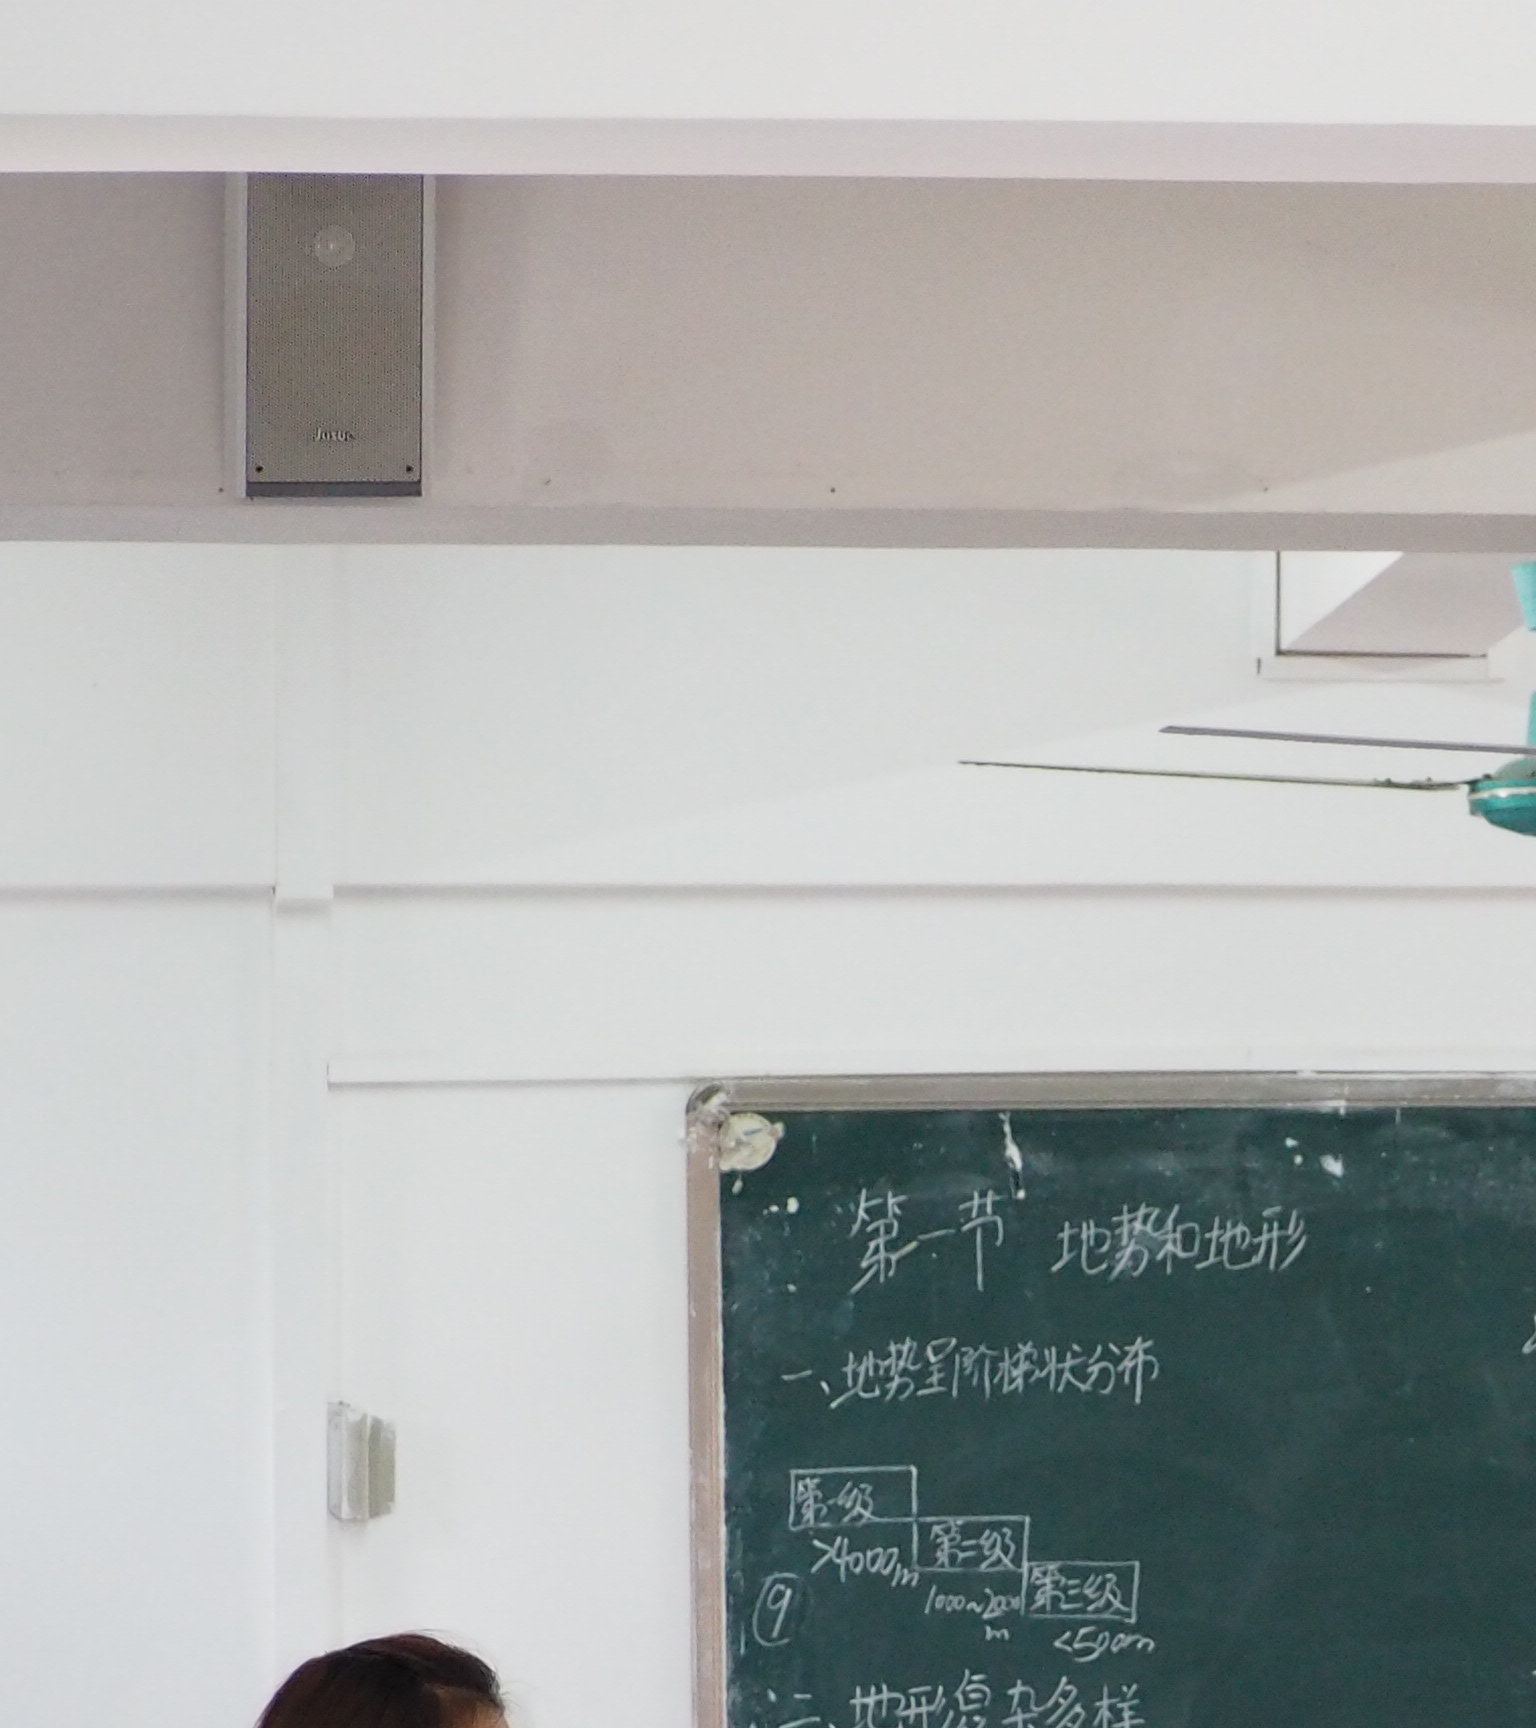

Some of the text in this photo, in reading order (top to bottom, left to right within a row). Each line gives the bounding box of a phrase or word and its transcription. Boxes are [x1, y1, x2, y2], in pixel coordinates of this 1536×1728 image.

[848, 1188, 1308, 1294] 第一节 地势和地形
[929, 1520, 1016, 1571] 第二级
